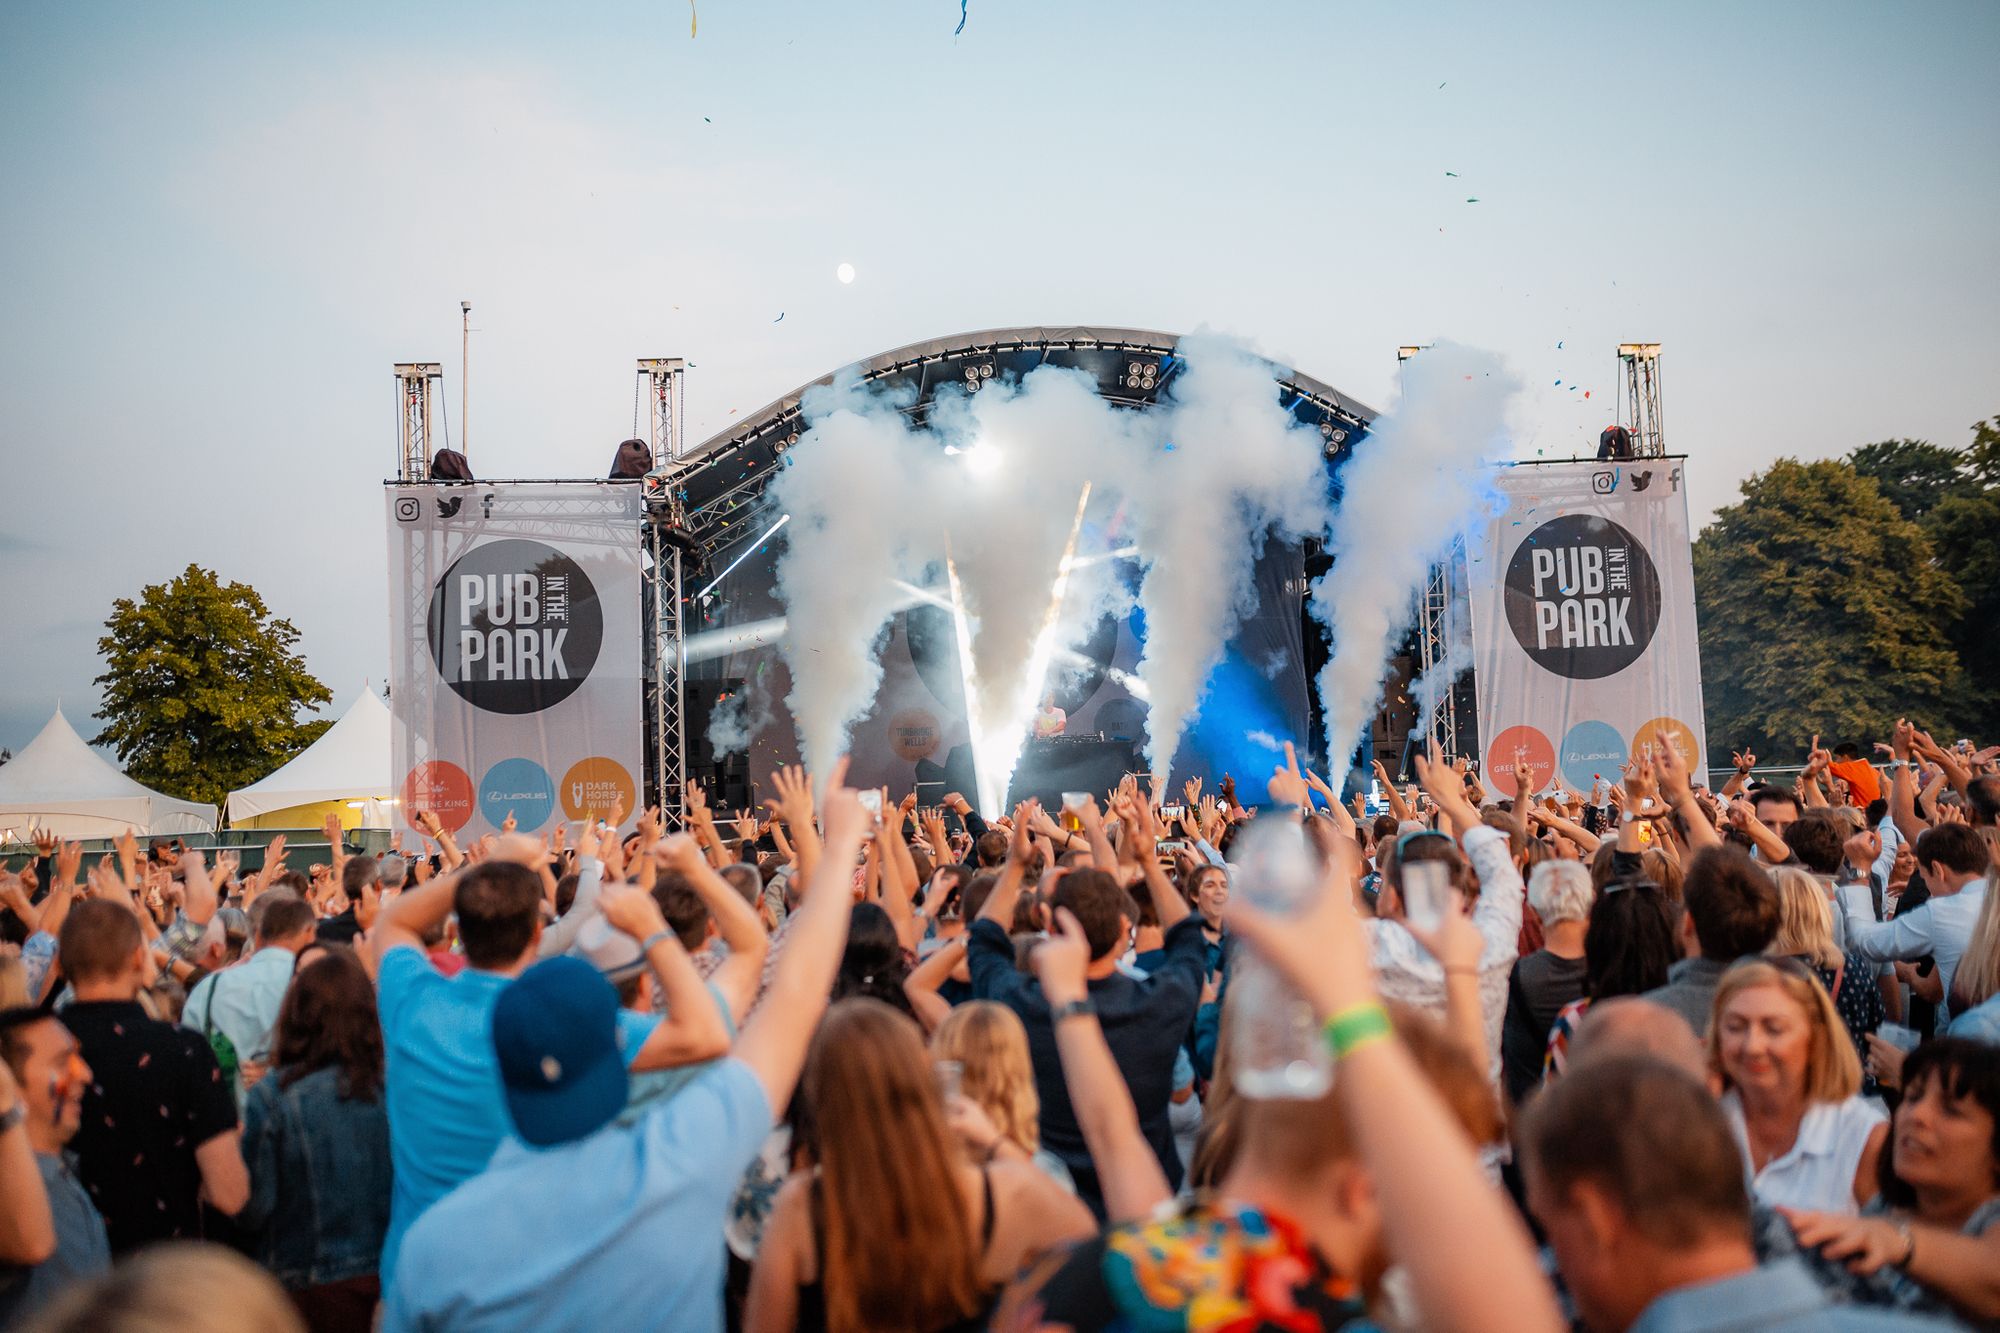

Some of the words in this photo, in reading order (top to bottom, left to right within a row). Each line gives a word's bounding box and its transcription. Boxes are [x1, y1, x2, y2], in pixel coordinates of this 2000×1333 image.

[1608, 548, 1625, 562] IN
[1532, 546, 1604, 597] PUB
[1610, 564, 1628, 590] THE
[546, 576, 565, 591] IN
[460, 573, 540, 626] PUB
[546, 593, 565, 621] THE
[1535, 596, 1635, 650] PARK
[461, 628, 569, 682] PARK
[1581, 752, 1620, 761] LEXUS
[586, 782, 617, 790] DARK
[503, 791, 548, 800] LEXUS
[586, 790, 625, 800] HORSE
[444, 799, 469, 808] KING
